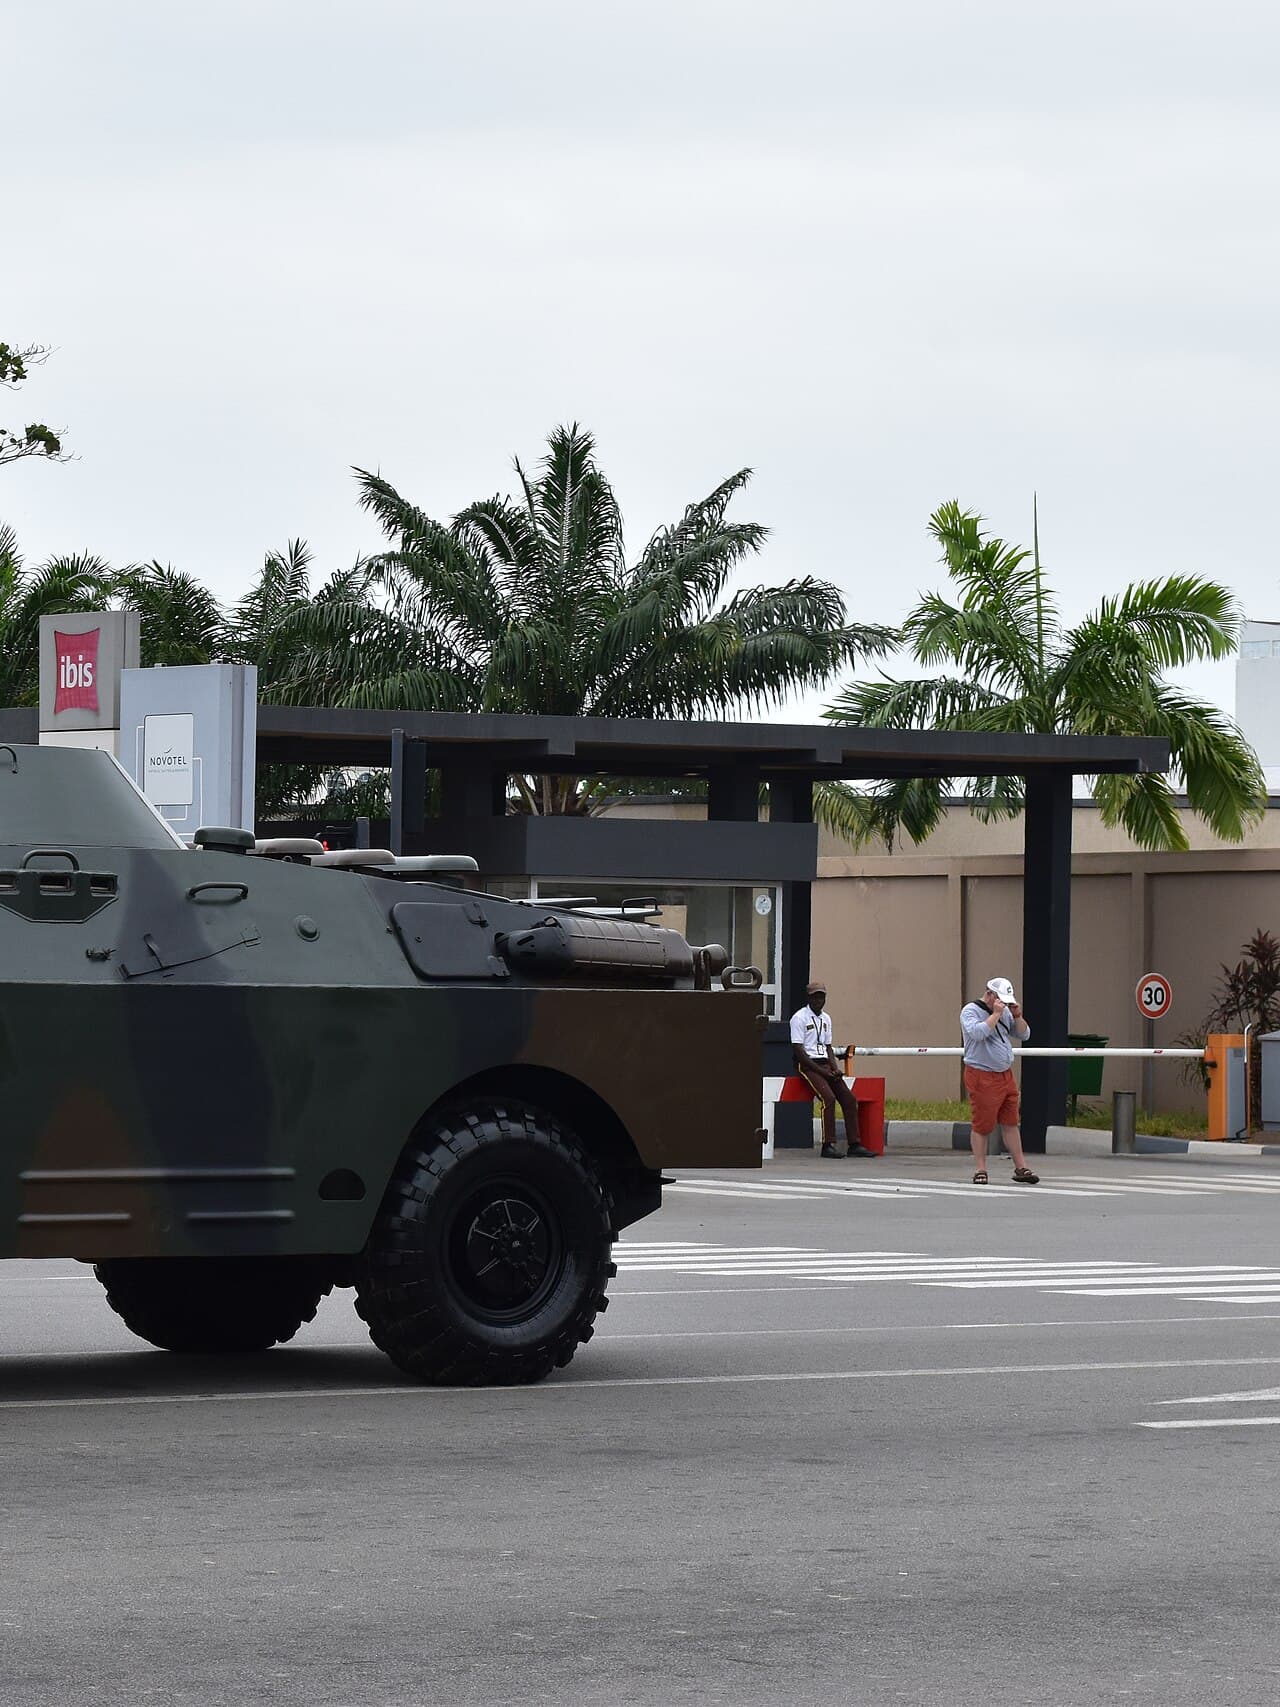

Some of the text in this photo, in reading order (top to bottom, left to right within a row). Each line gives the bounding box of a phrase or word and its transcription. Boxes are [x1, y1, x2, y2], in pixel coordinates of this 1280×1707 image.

[60, 655, 93, 688] ibis
[149, 756, 187, 766] NOVOTEL
[1144, 987, 1165, 1005] 30
